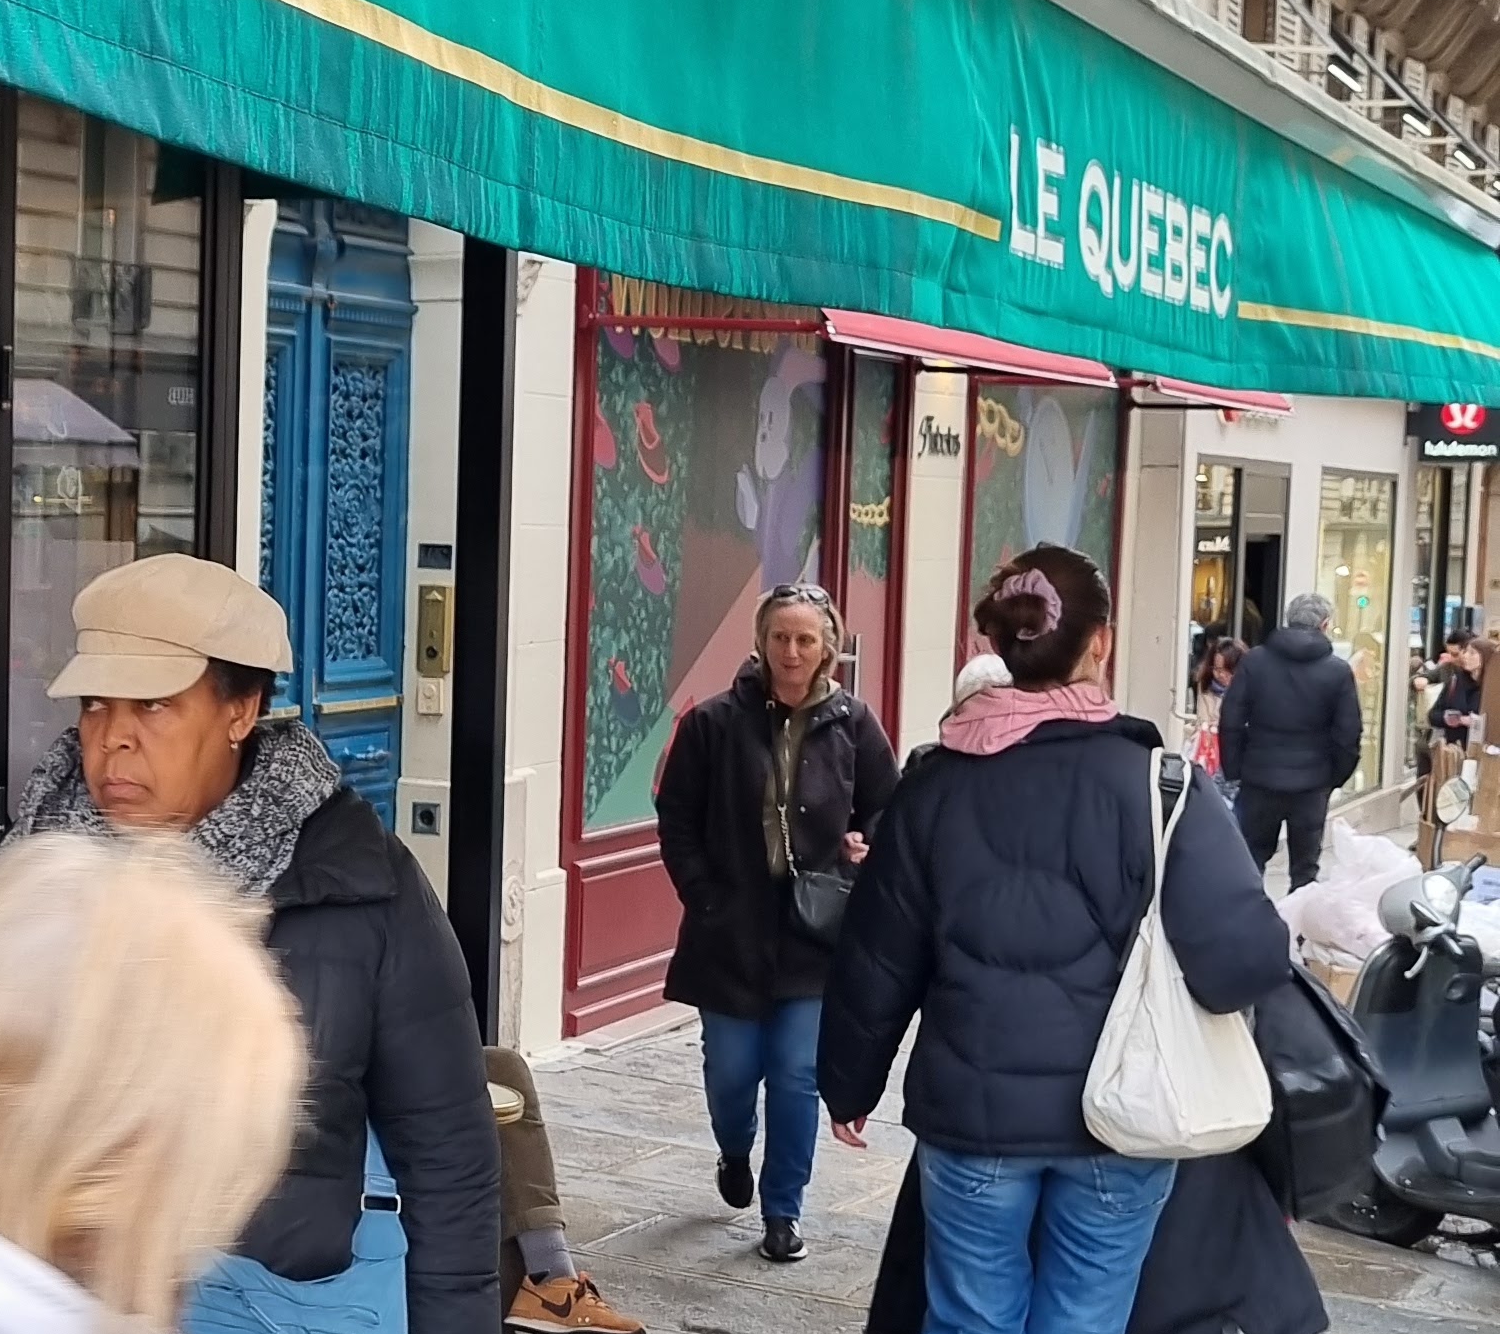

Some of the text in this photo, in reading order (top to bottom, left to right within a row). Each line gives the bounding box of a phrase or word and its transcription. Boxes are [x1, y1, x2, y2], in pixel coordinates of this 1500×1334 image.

[1009, 123, 1234, 319] LE QUEBEC
[1424, 440, 1498, 457] lululemon
